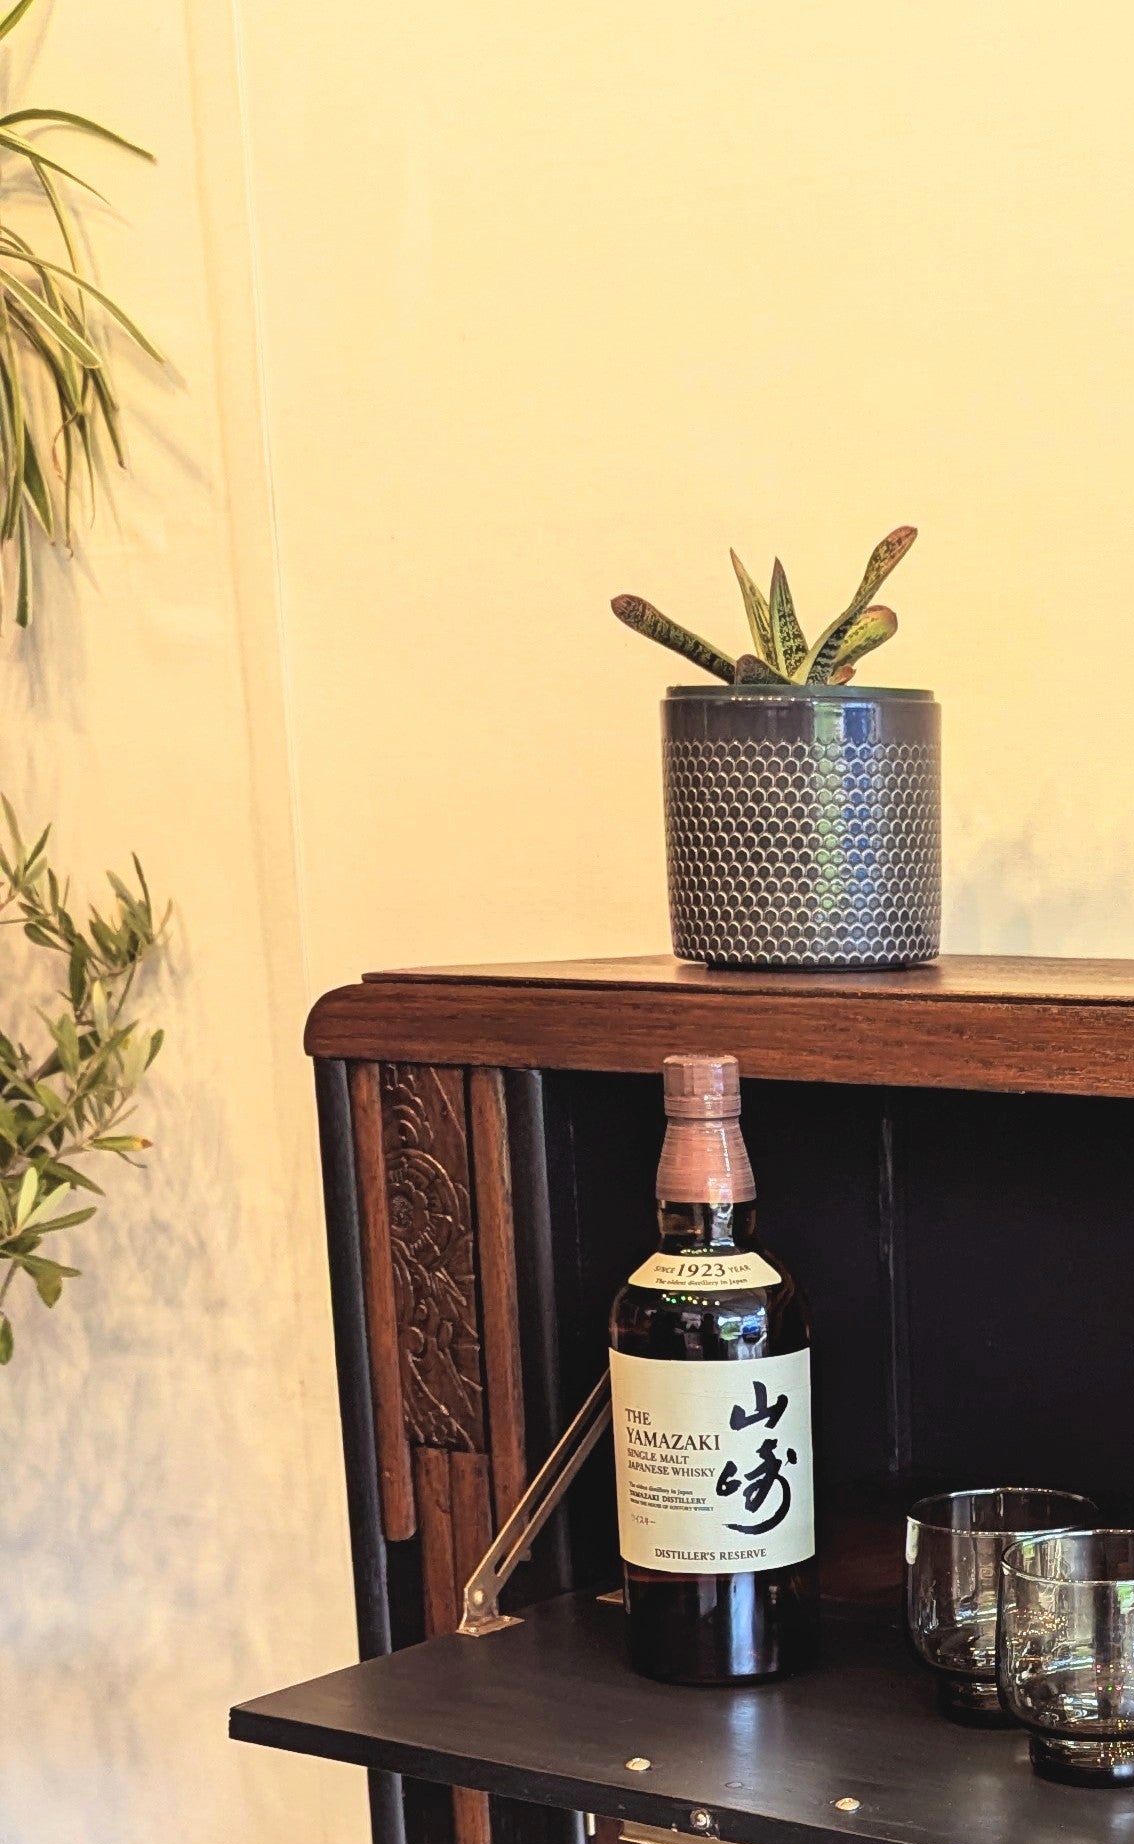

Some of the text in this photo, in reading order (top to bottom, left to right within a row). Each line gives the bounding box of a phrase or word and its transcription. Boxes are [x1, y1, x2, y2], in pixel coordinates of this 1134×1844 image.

[653, 1263, 751, 1277] SINCE 1923 YEAR
[625, 1408, 651, 1426] THE
[626, 1426, 720, 1450] YAMAZAKI
[627, 1448, 689, 1465] SINGLE MALT
[628, 1460, 716, 1477] JAPANESE WHISKY
[629, 1489, 707, 1504] YAMAZAKI DISTILLERY
[655, 1548, 767, 1560] DISTILLER'S RESERVE
